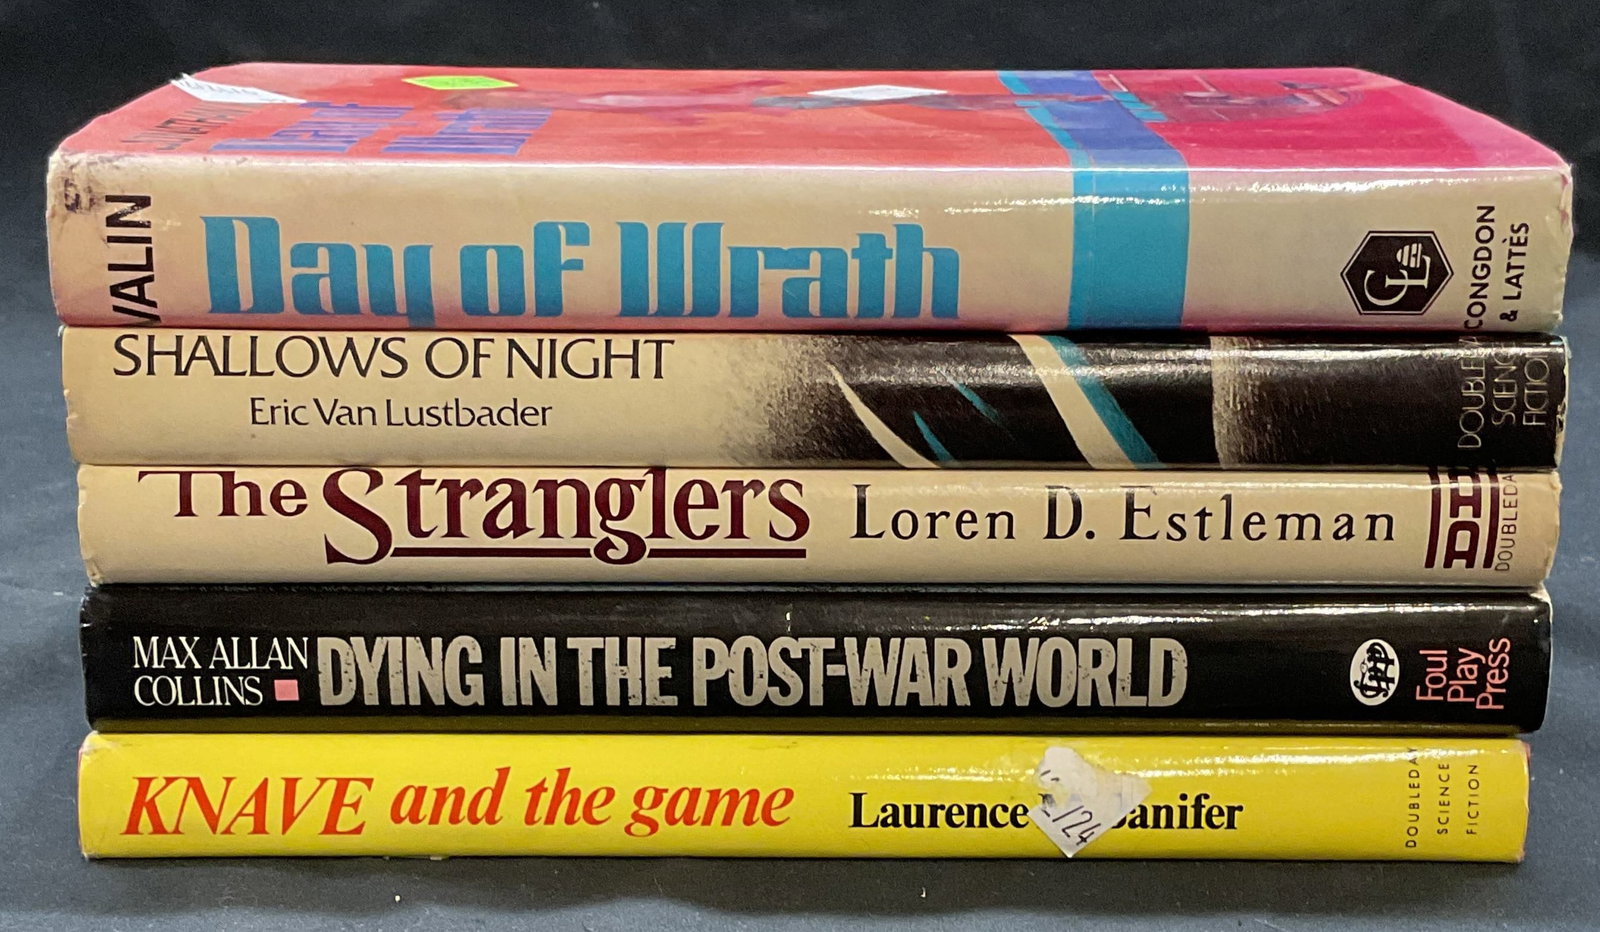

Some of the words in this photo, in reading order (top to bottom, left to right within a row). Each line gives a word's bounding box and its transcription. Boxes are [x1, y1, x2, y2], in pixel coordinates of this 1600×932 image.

[200, 216, 436, 328] Day
[616, 222, 959, 318] Wrath
[1463, 205, 1495, 329] CONGDON
[1503, 223, 1529, 301] LATTÈS
[1499, 308, 1518, 322] &
[114, 334, 407, 378] SHALLOWS
[425, 337, 494, 378] OF
[507, 338, 674, 379] NIGHT
[250, 398, 308, 426] Eric
[314, 398, 376, 426] Van
[386, 398, 552, 427] Lustbader
[139, 471, 308, 516] The
[322, 467, 809, 564] Stranglers
[850, 484, 1015, 540] Loren
[1044, 486, 1095, 540] D.
[1119, 486, 1395, 541] Estleman
[1495, 474, 1518, 571] DOUBLEDA
[134, 636, 200, 669] MAX
[209, 637, 308, 670] ALLAN
[317, 635, 484, 706] DYING
[501, 637, 557, 706] IN
[567, 637, 678, 706] THE
[693, 636, 971, 707] POST-WAR
[981, 637, 1188, 707] WORLD
[1416, 650, 1448, 700] Foul
[1447, 648, 1486, 702] Play
[1475, 638, 1511, 709] Press
[134, 676, 263, 706] COLLINS
[120, 777, 375, 835] KNAVE
[390, 766, 511, 826] and
[524, 767, 615, 826] the
[624, 786, 794, 837] game
[849, 792, 1029, 828] Laurence
[1437, 763, 1450, 834] SCIENCE
[1466, 764, 1480, 834] FICTION
